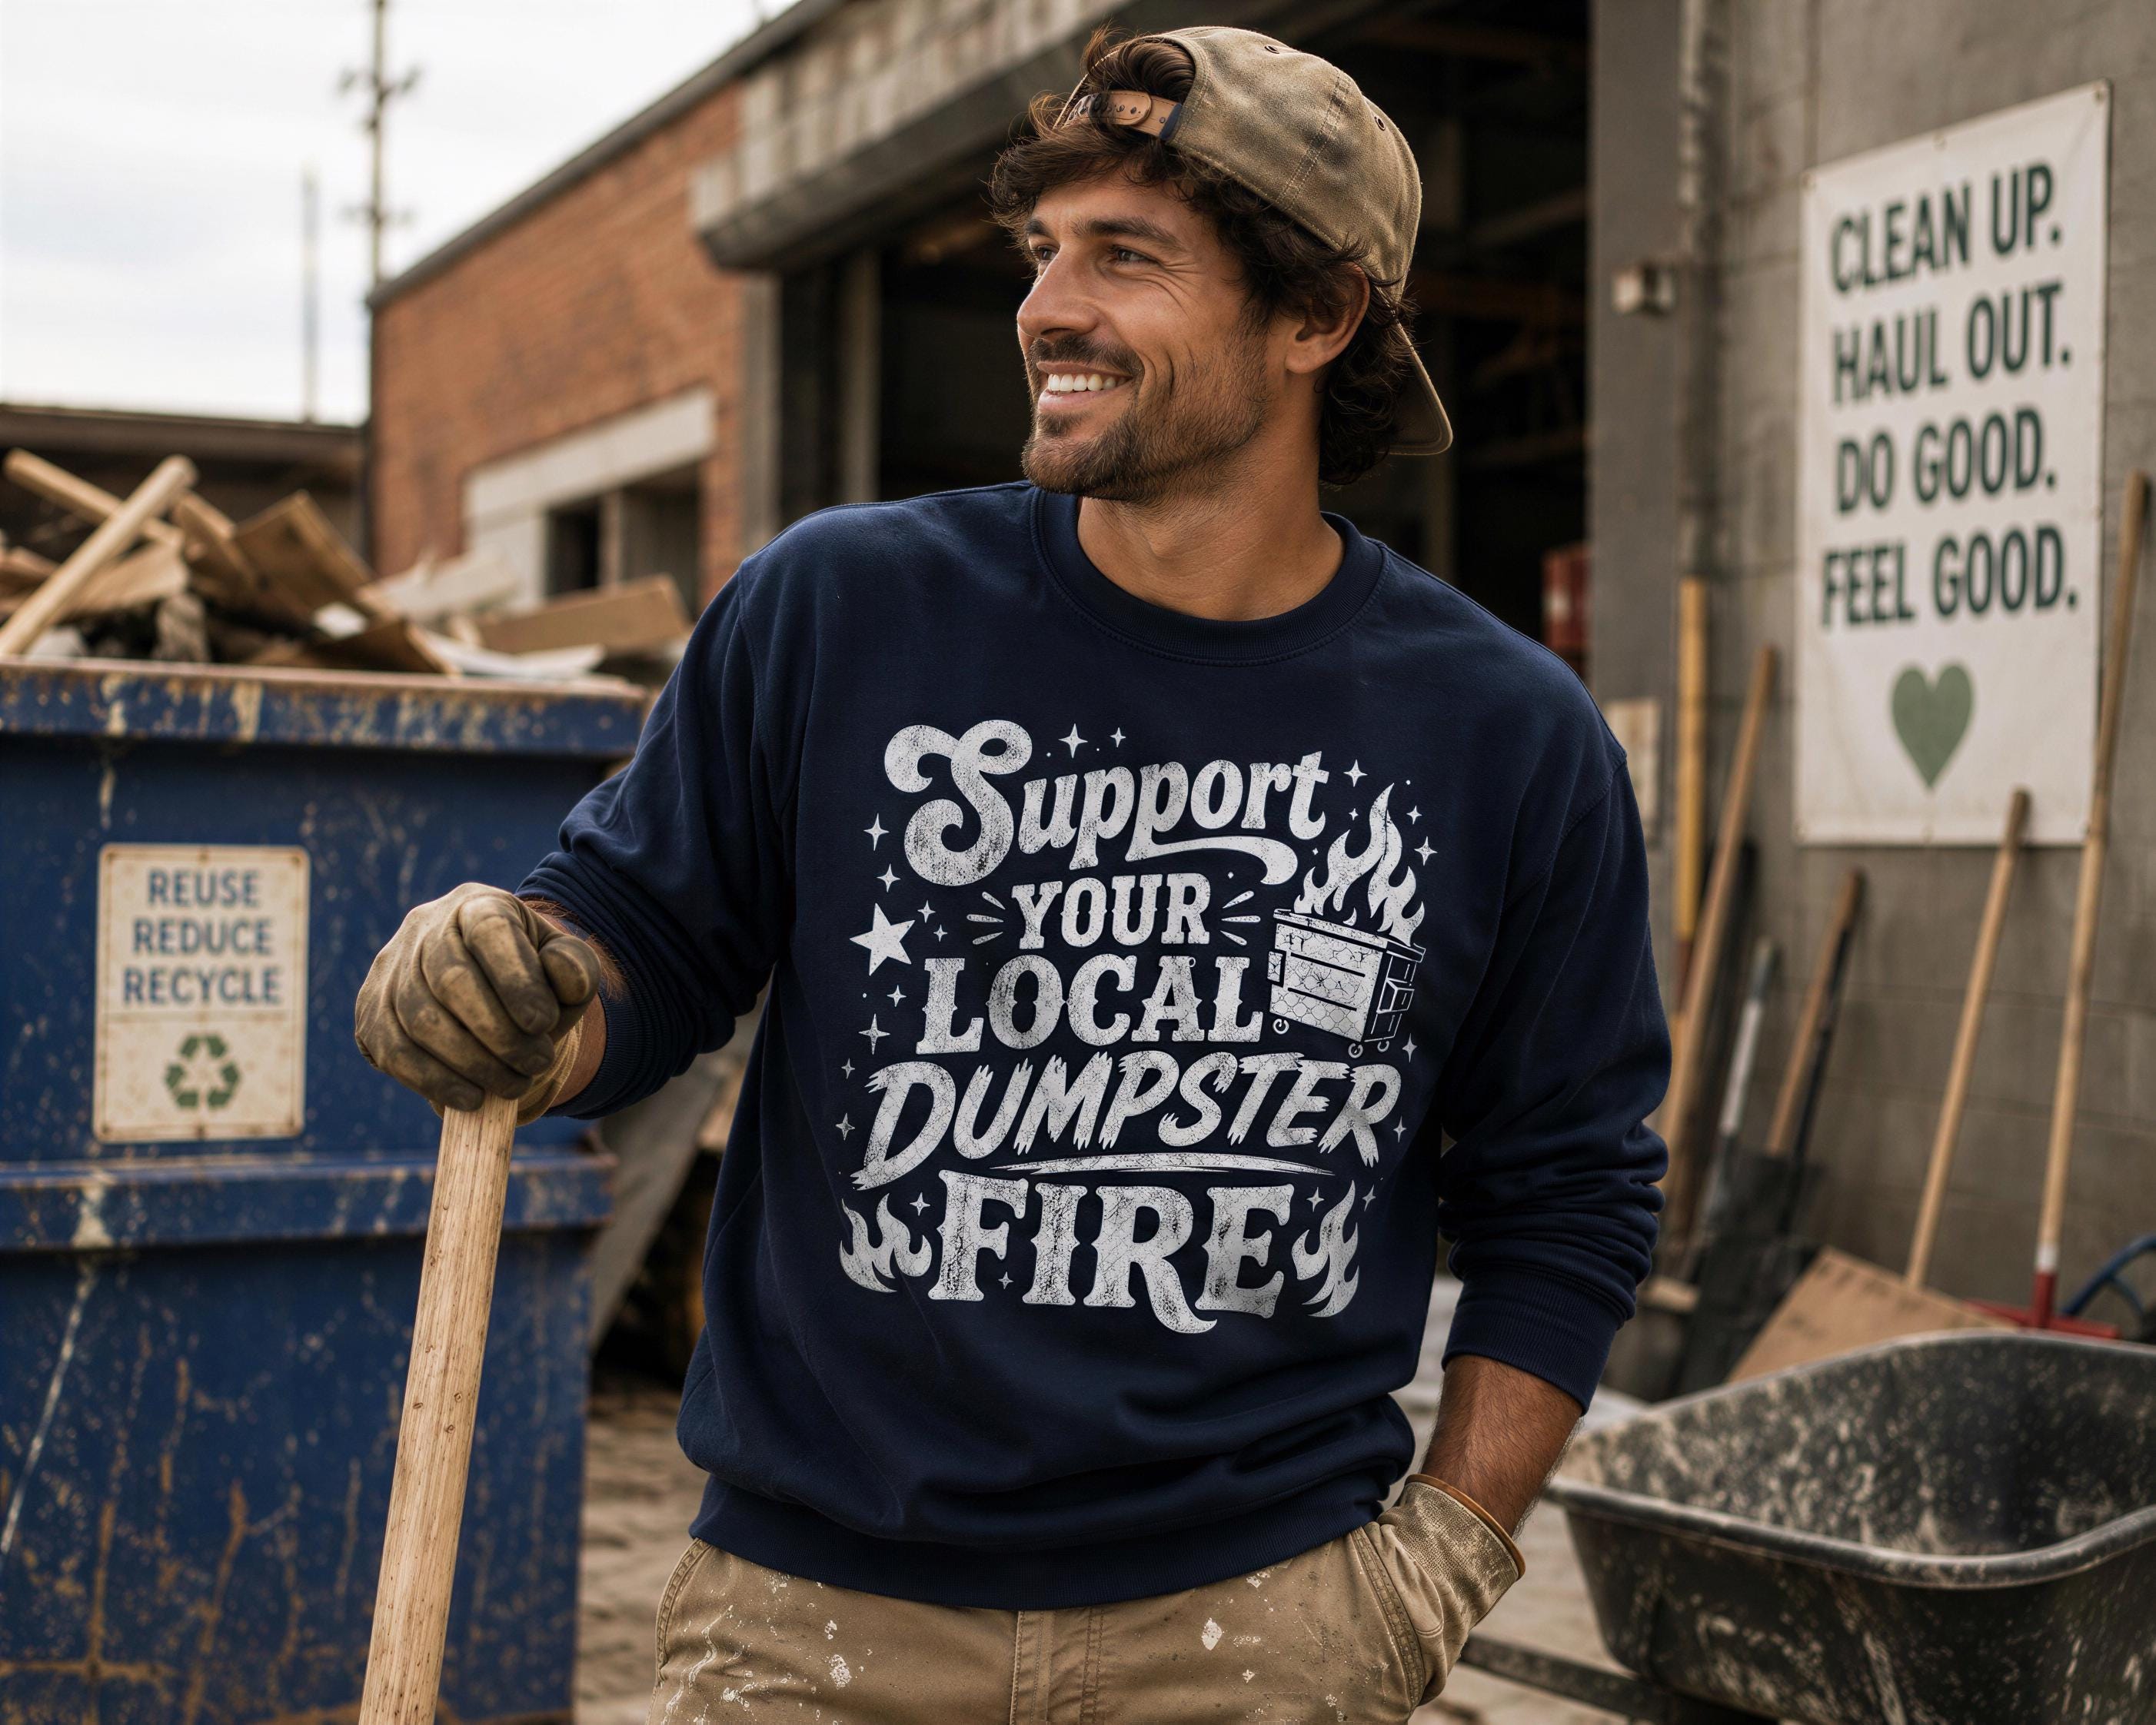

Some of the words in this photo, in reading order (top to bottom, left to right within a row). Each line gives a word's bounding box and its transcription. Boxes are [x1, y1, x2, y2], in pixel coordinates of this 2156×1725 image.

[1830, 182, 1971, 294] CLEAN
[1991, 164, 2061, 256] UP.
[1831, 307, 1948, 407] HAUL
[1966, 281, 2071, 381] OUT.
[1835, 431, 1894, 514] DO
[1914, 408, 2057, 505] GOOD.
[1821, 544, 1914, 627] FEEL
[1931, 525, 2078, 618] GOOD.
[883, 720, 1330, 886] Support
[133, 918, 274, 956] REDUCE
[148, 869, 260, 907] REUSE
[1011, 872, 1212, 949] YOUR
[123, 967, 282, 1005] RECYCLE
[915, 953, 1263, 1055] LOCAL
[851, 1051, 1402, 1192] DUMPSTER
[927, 1169, 1295, 1334] FIRE
